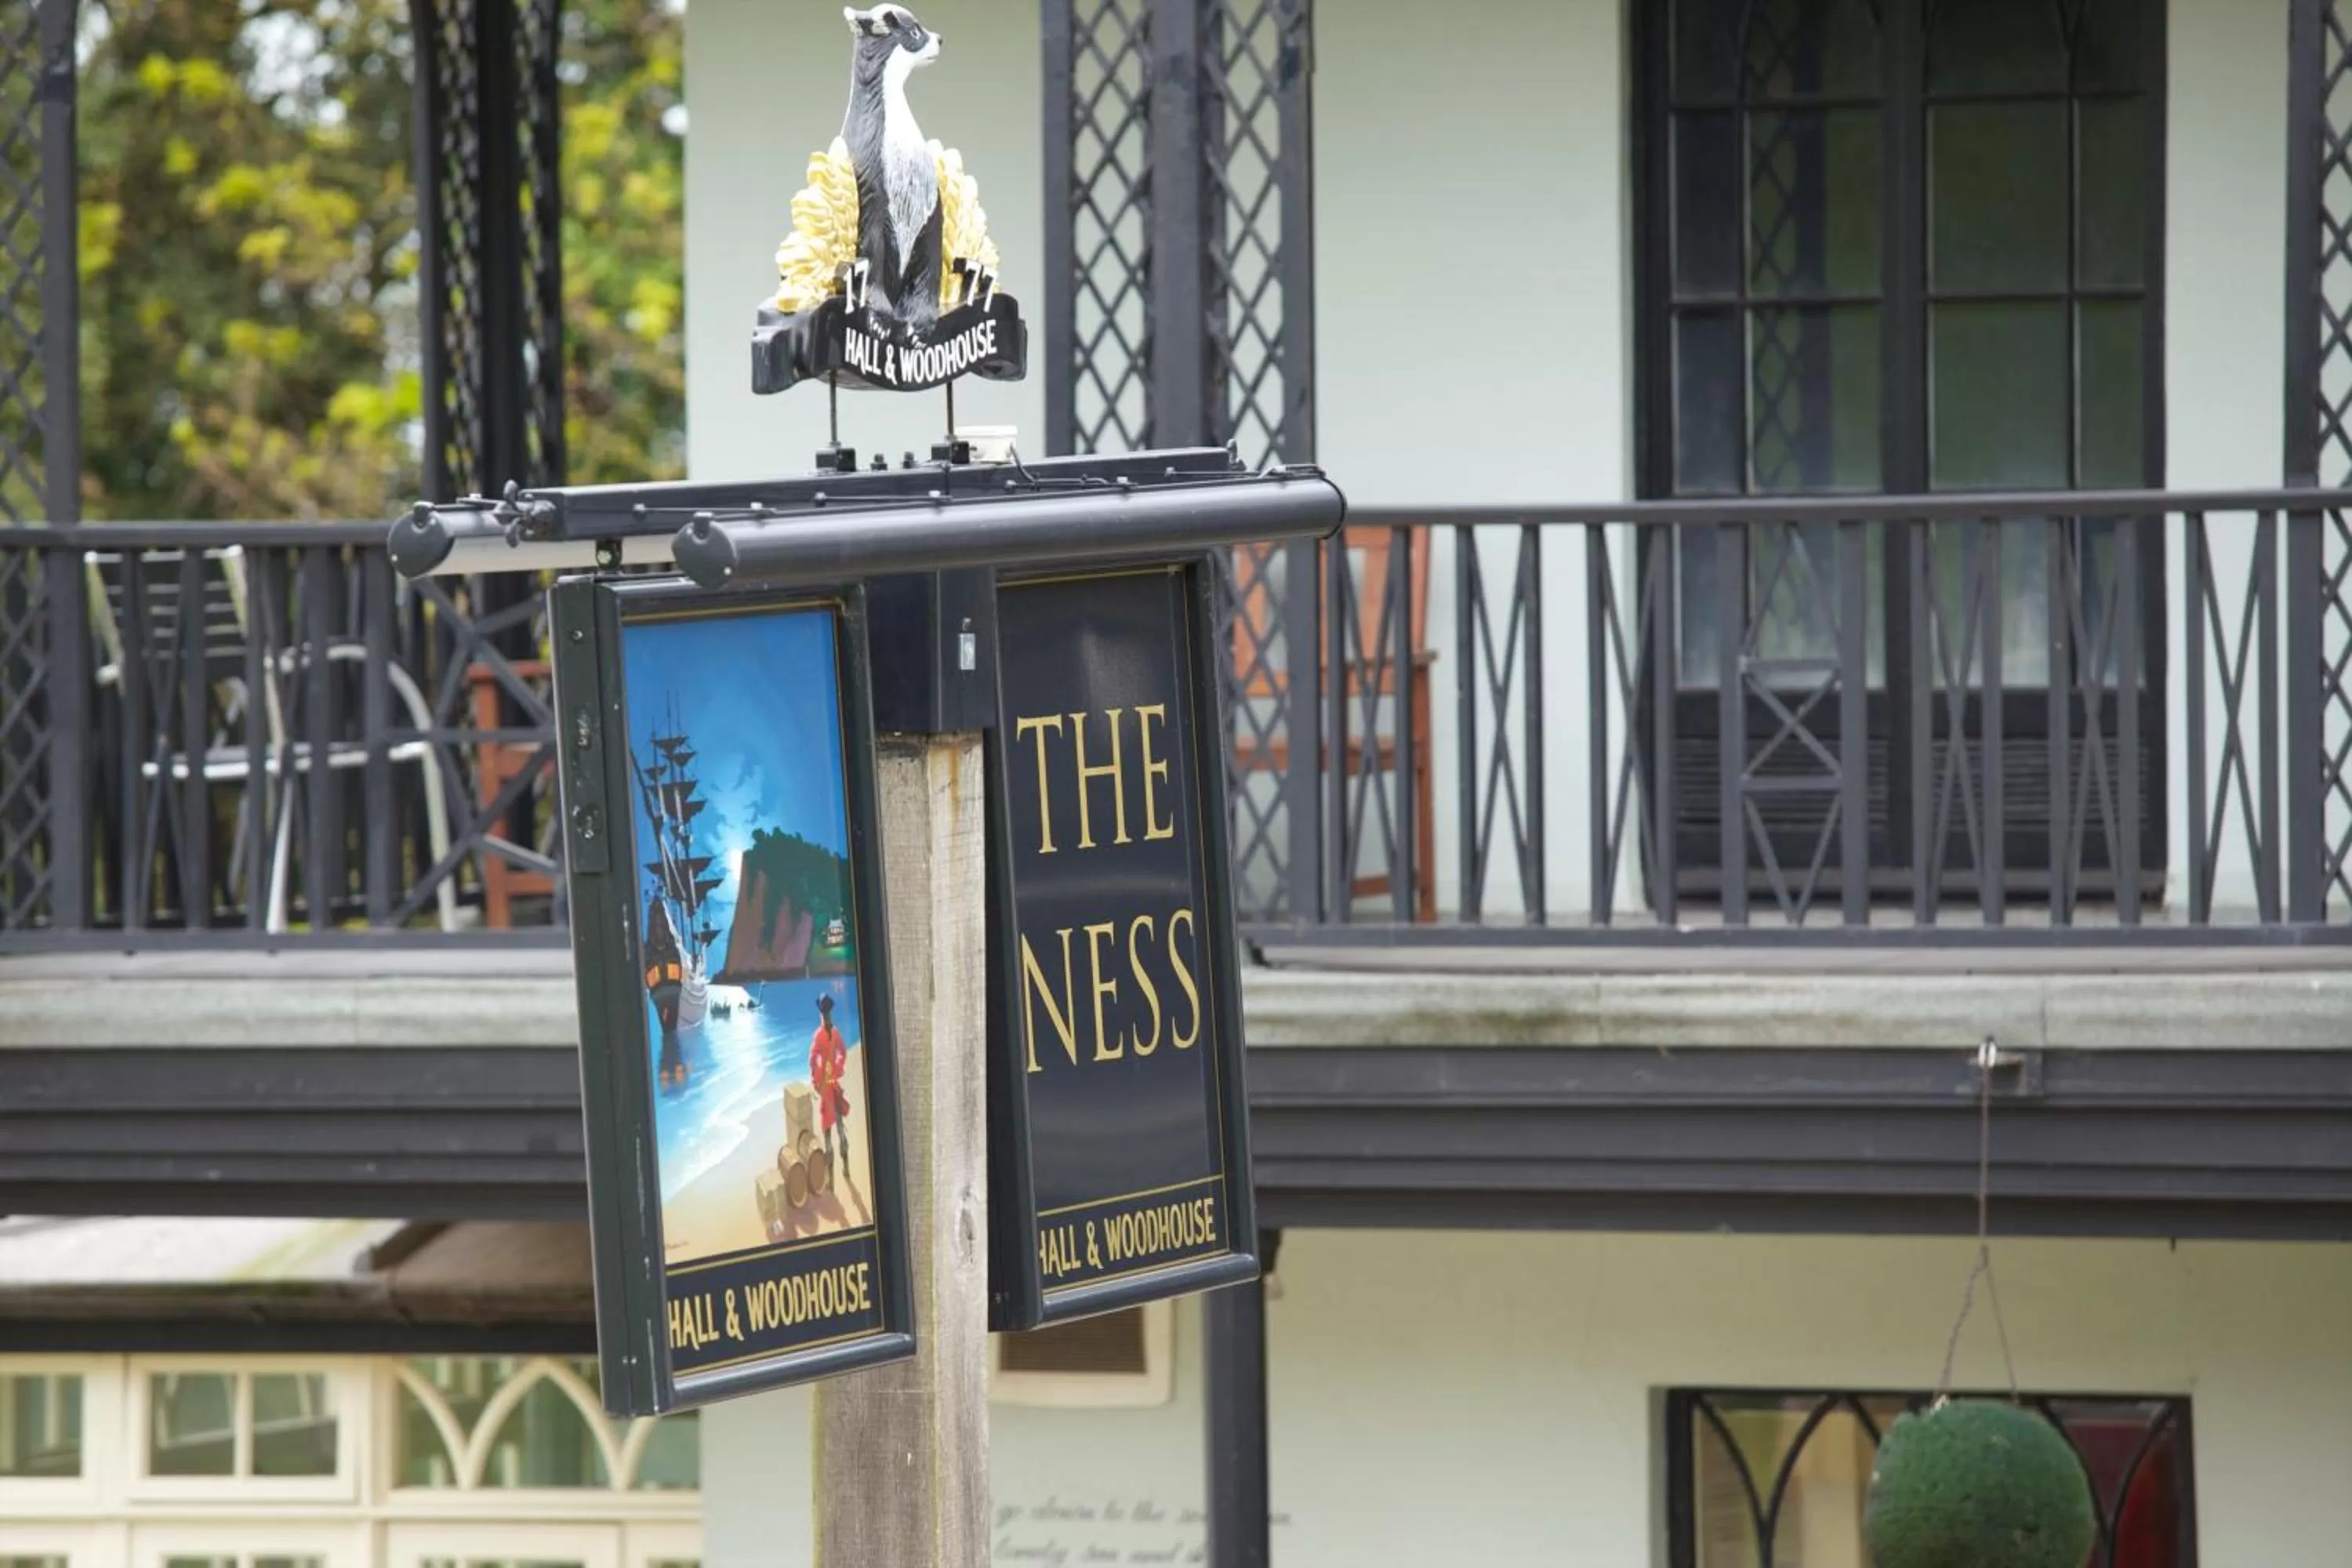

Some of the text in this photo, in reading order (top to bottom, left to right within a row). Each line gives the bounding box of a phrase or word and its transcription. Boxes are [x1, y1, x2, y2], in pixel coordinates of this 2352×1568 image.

[843, 257, 998, 314] 17 77
[844, 319, 997, 385] HALL & WOODHOUSE
[1016, 702, 1174, 854] THE
[1021, 908, 1201, 1073] NESS
[1085, 1220, 1105, 1270] &
[1103, 1197, 1217, 1261] WOODHOUSE
[666, 1261, 873, 1352] HALL & WOODHOUSE
